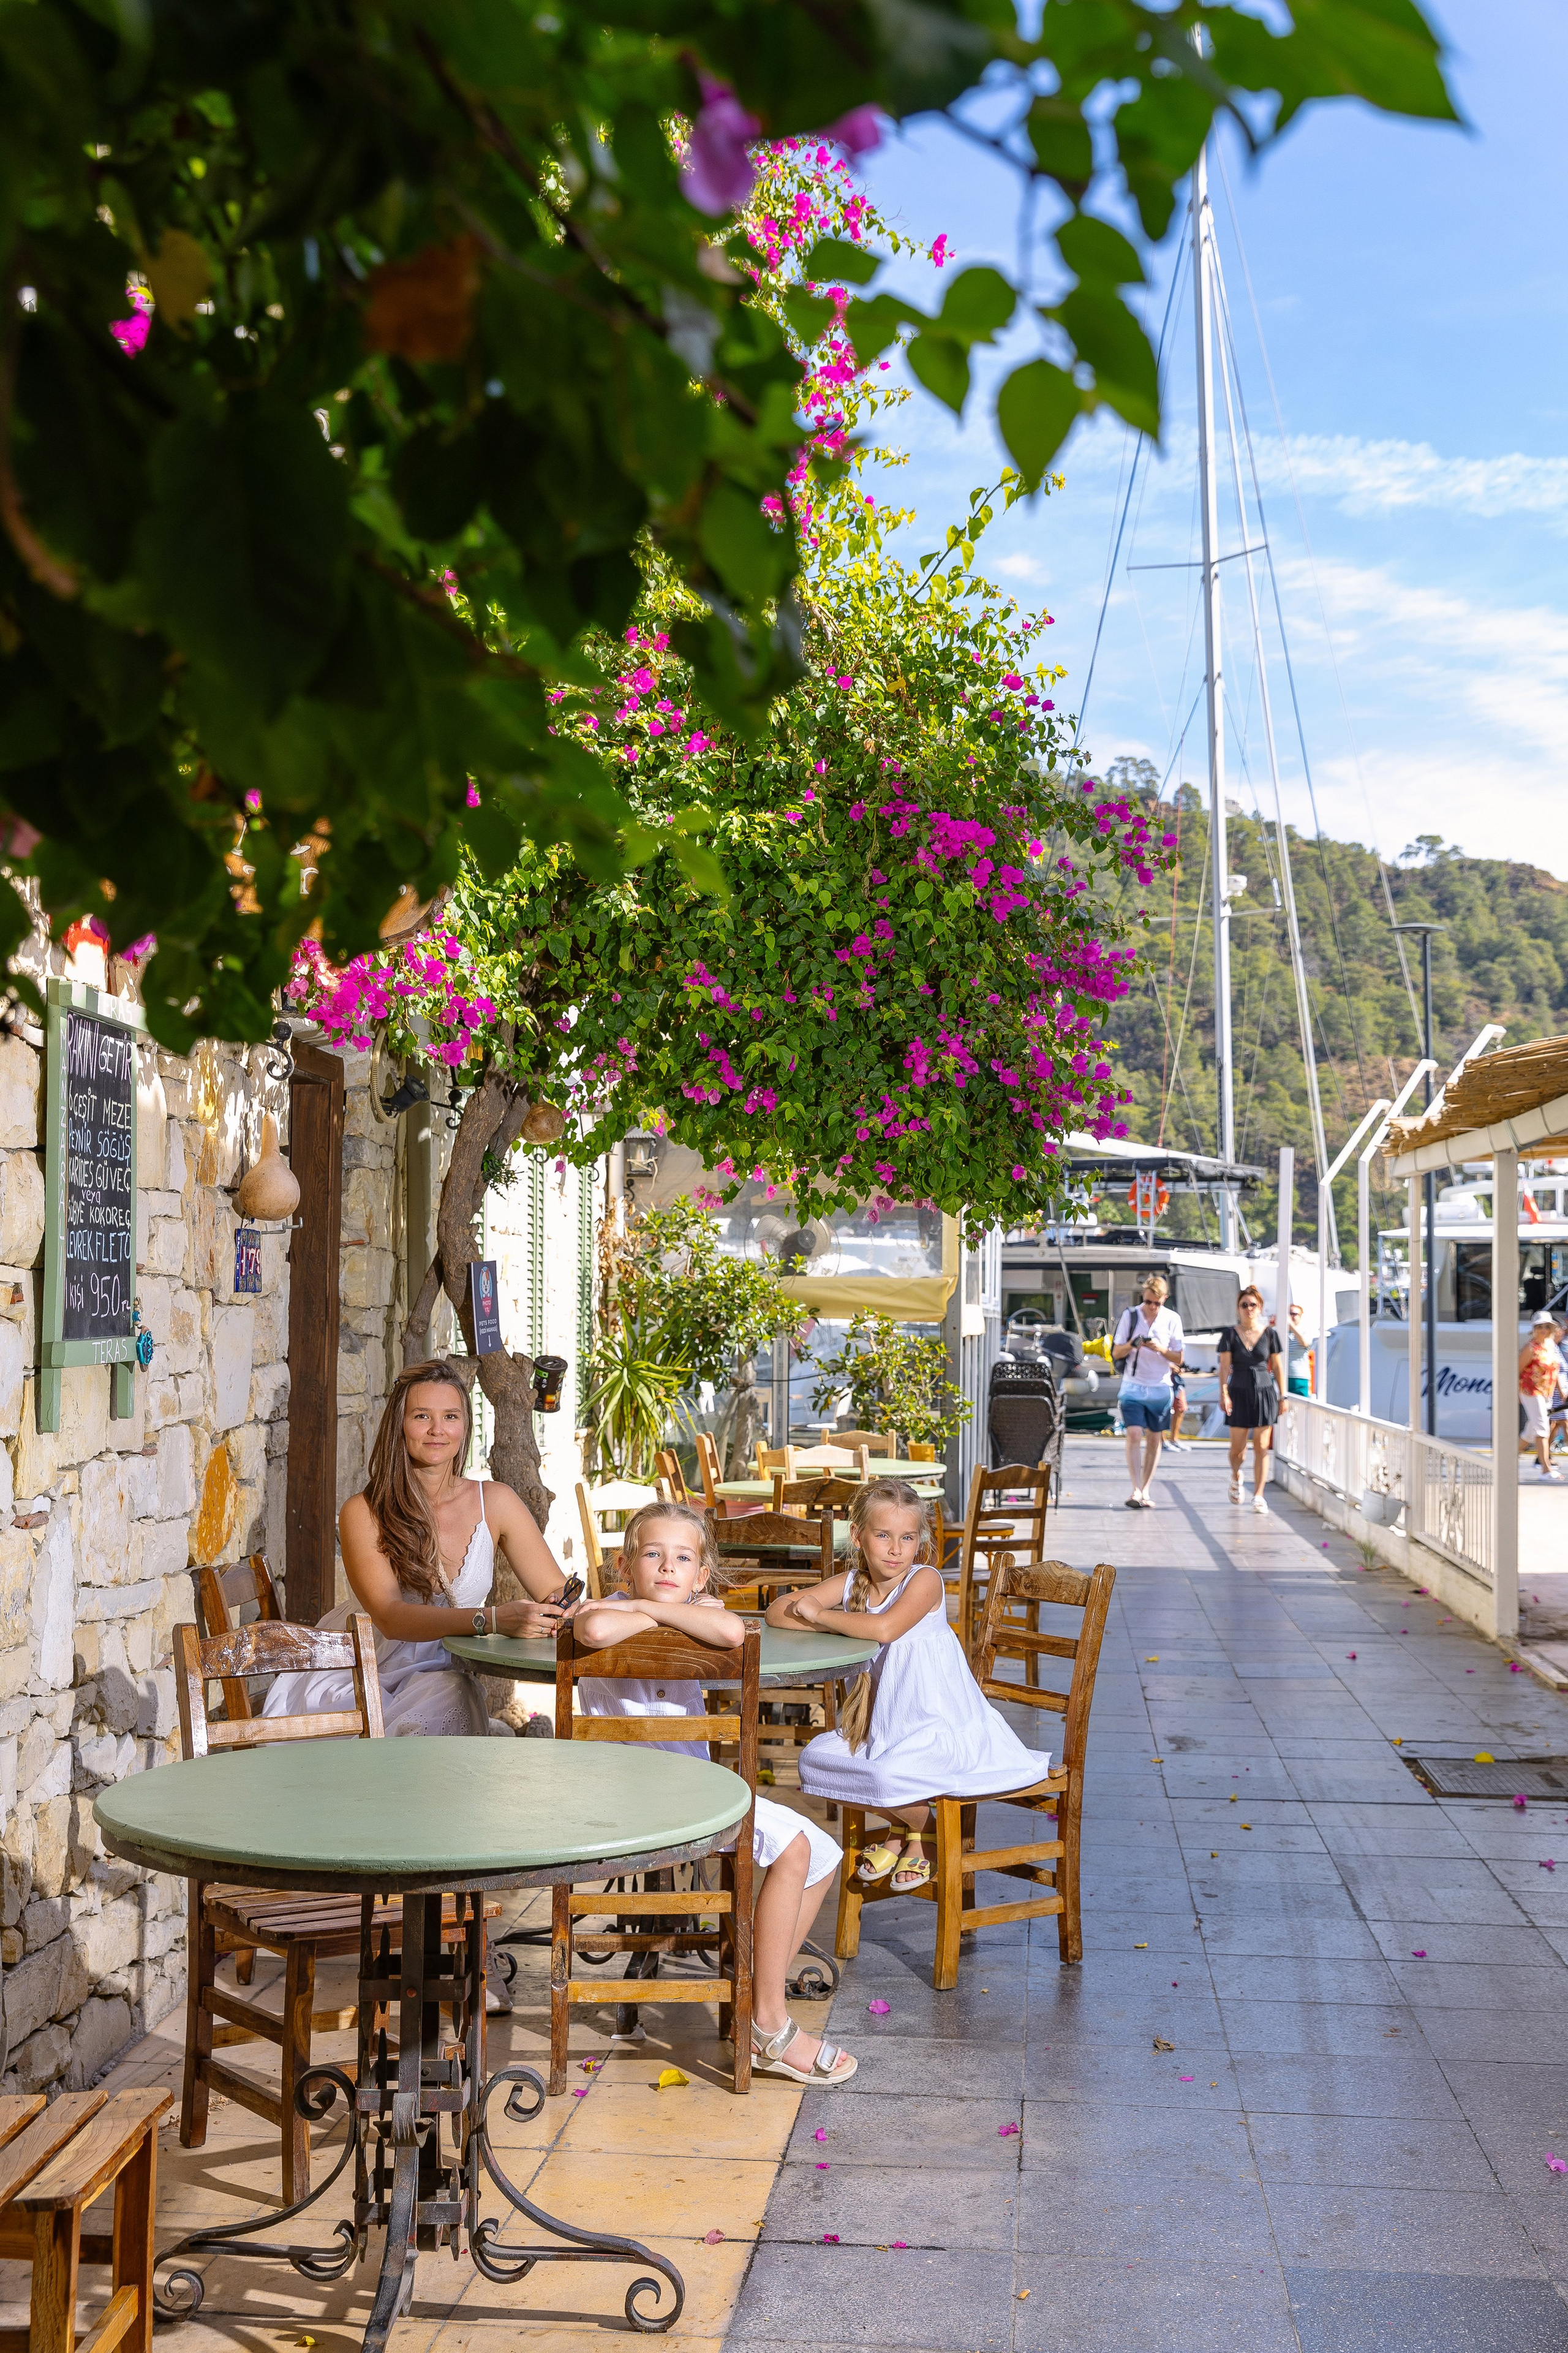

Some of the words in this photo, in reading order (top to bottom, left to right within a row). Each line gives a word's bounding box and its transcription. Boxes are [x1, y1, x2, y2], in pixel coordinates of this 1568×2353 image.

[102, 1097, 132, 1130] MEZE
[96, 1160, 132, 1193] GÜVEÇ
[67, 1228, 94, 1261] LEVREK
[241, 1246, 262, 1276] 179
[91, 1272, 120, 1318] 950
[92, 1339, 128, 1365] TERAS
